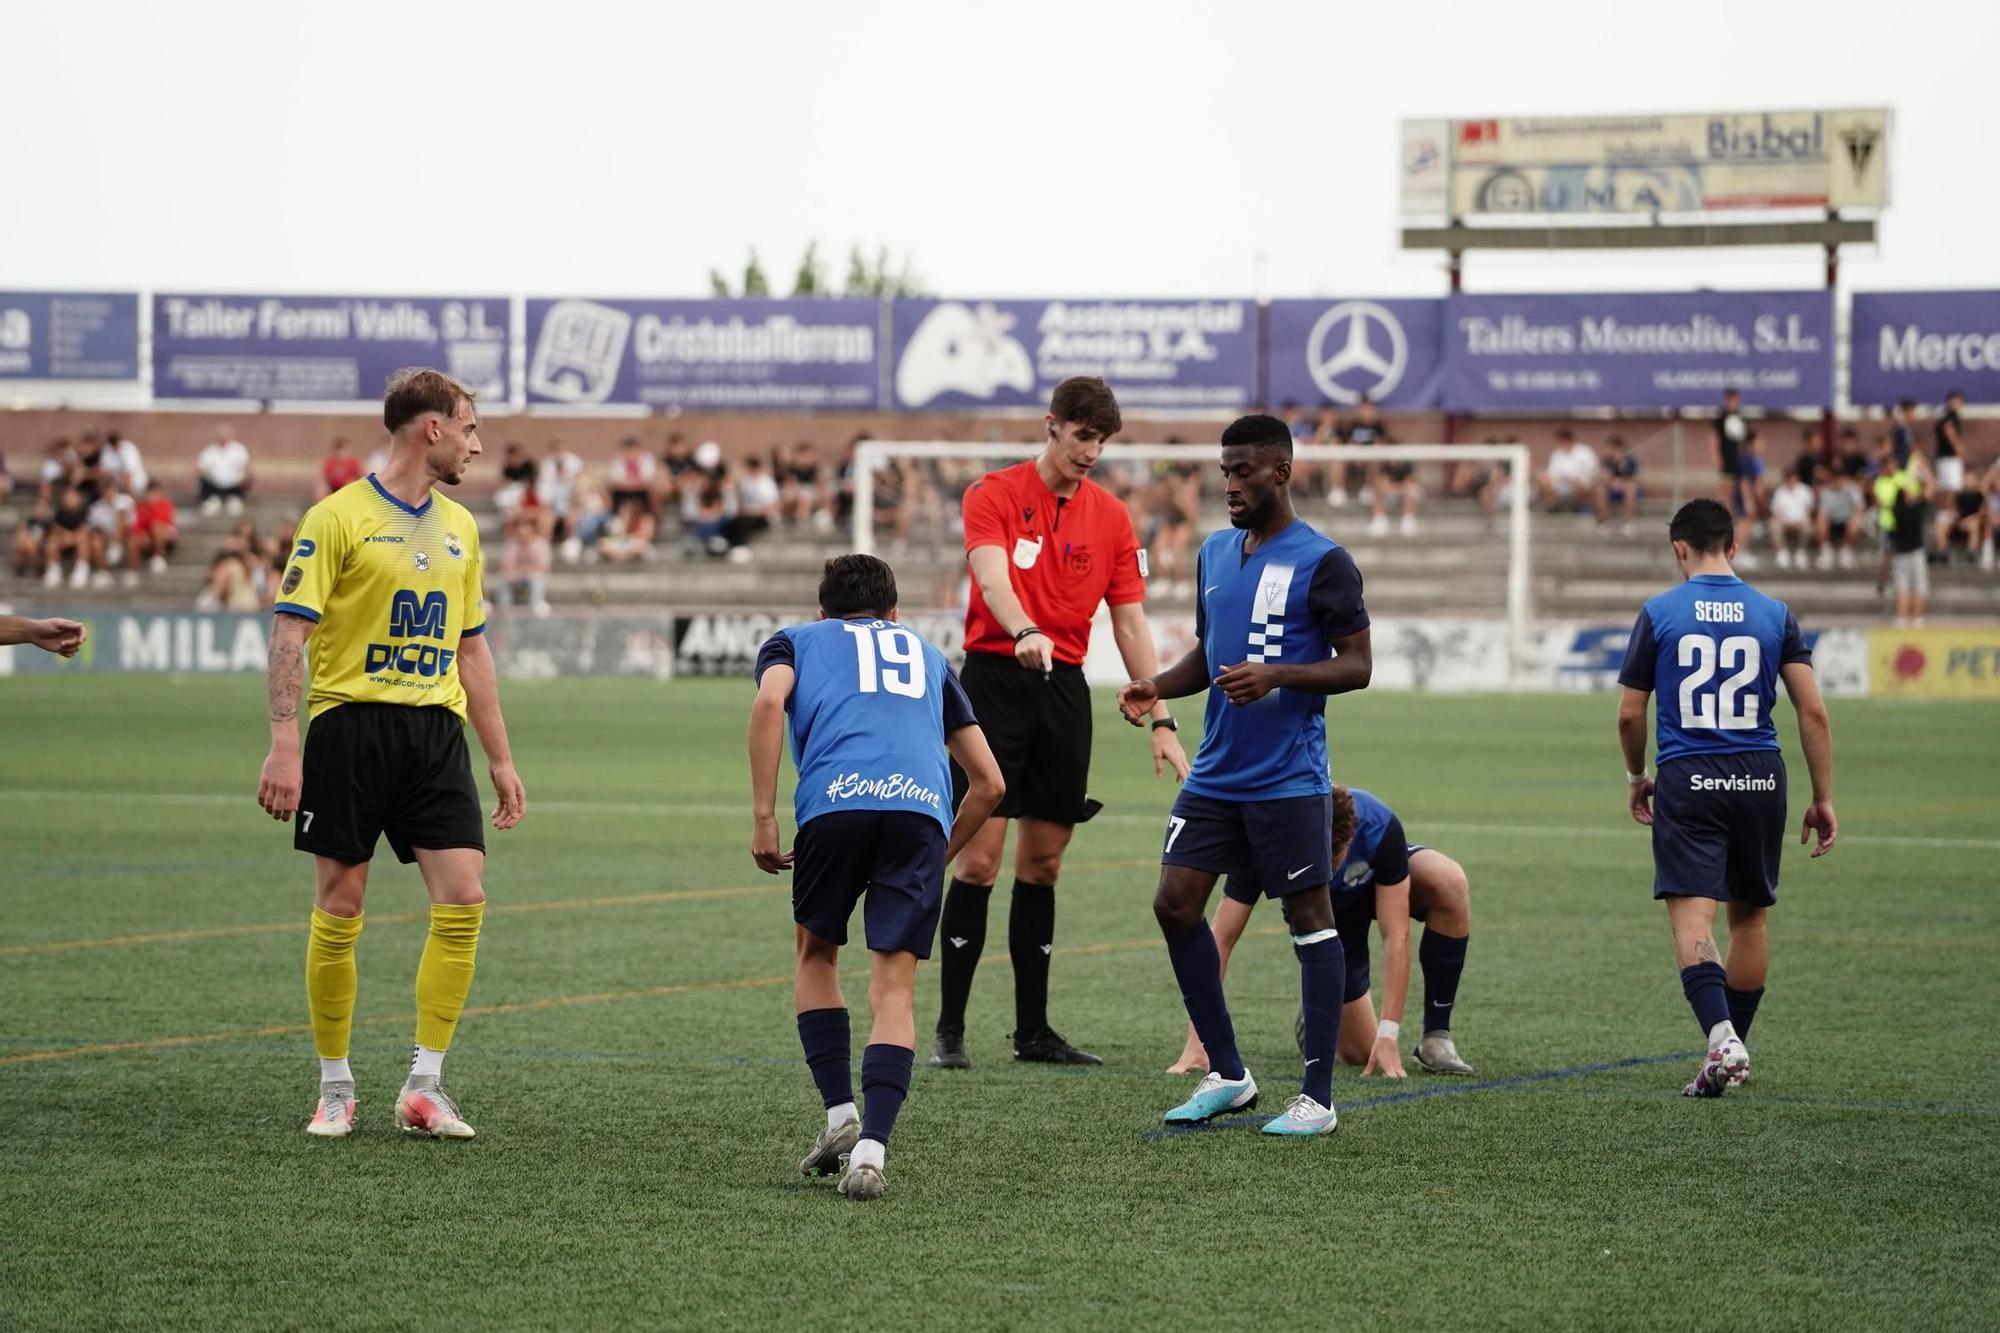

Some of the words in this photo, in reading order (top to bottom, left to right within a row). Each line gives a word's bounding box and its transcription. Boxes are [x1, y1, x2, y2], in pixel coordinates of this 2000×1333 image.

[1708, 111, 1824, 160] Bisbal
[167, 298, 254, 338] Taller
[1459, 315, 1574, 354] Tallers
[372, 536, 405, 544] PATRICK
[1694, 600, 1744, 622] SEBAS
[843, 623, 926, 699] 19
[1678, 634, 1760, 729] 22
[1690, 773, 1775, 791] Servisimó
[303, 811, 313, 833] 7
[1164, 816, 1187, 853] 7
